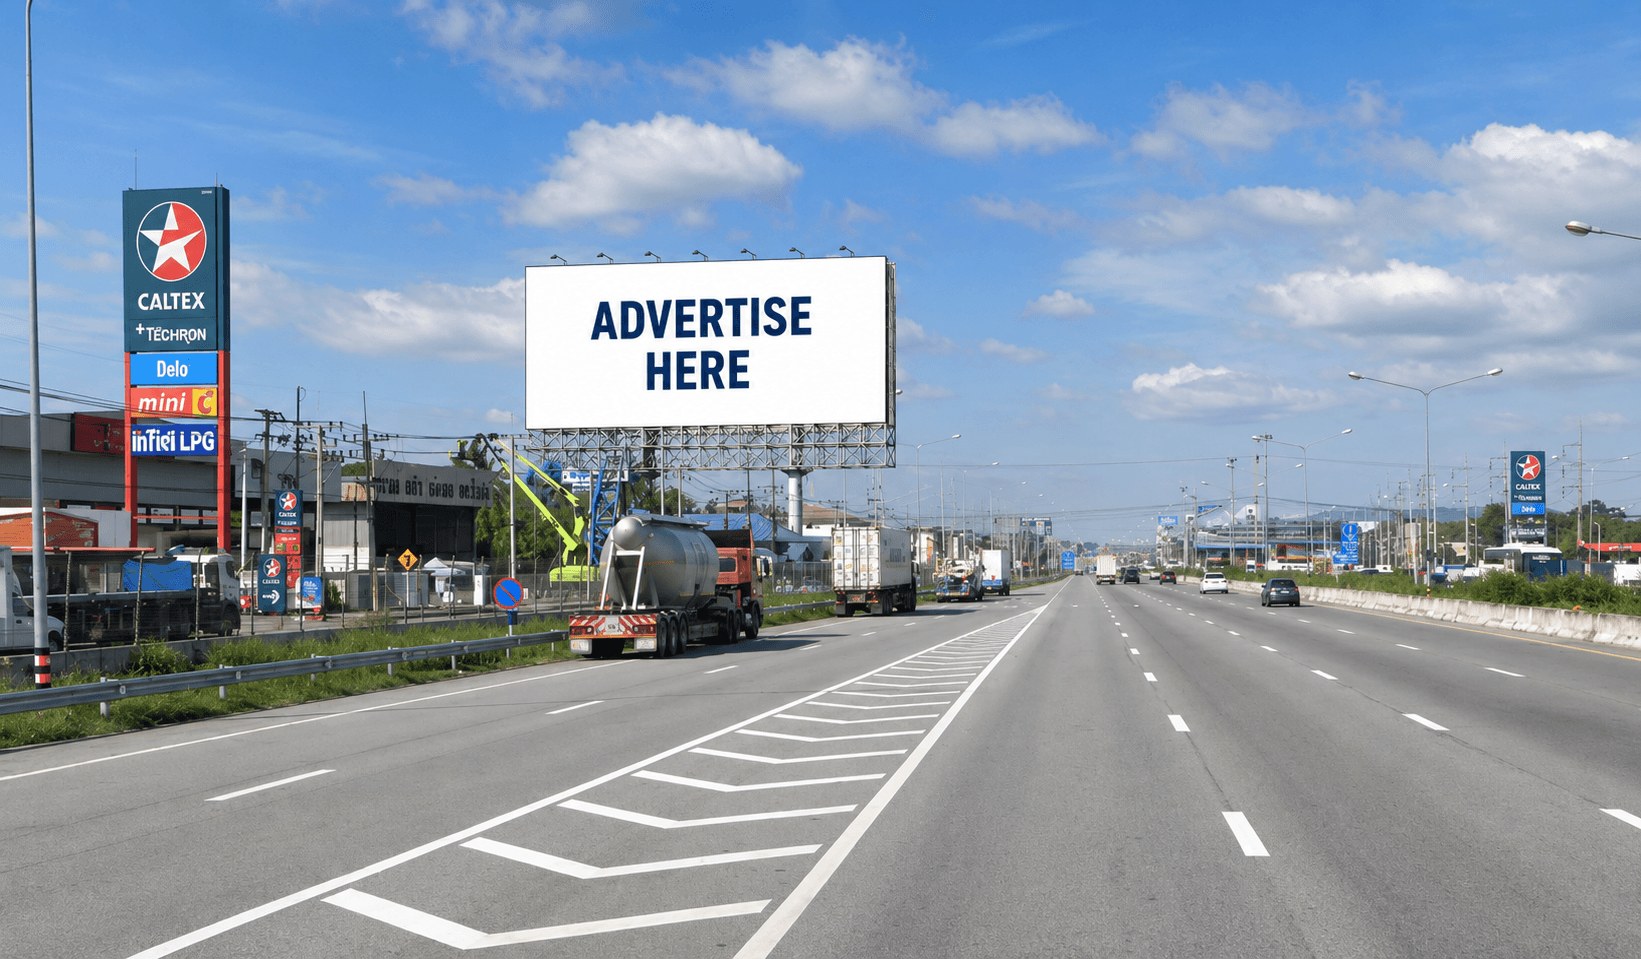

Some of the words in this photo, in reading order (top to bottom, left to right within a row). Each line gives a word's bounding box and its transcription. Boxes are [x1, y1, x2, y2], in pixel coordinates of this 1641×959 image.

[138, 292, 205, 311] CALTEX
[591, 296, 812, 340] ADVERTISE
[157, 360, 188, 378] Delo
[646, 350, 750, 391] HERE
[138, 392, 186, 412] mini
[180, 430, 215, 451] LPG
